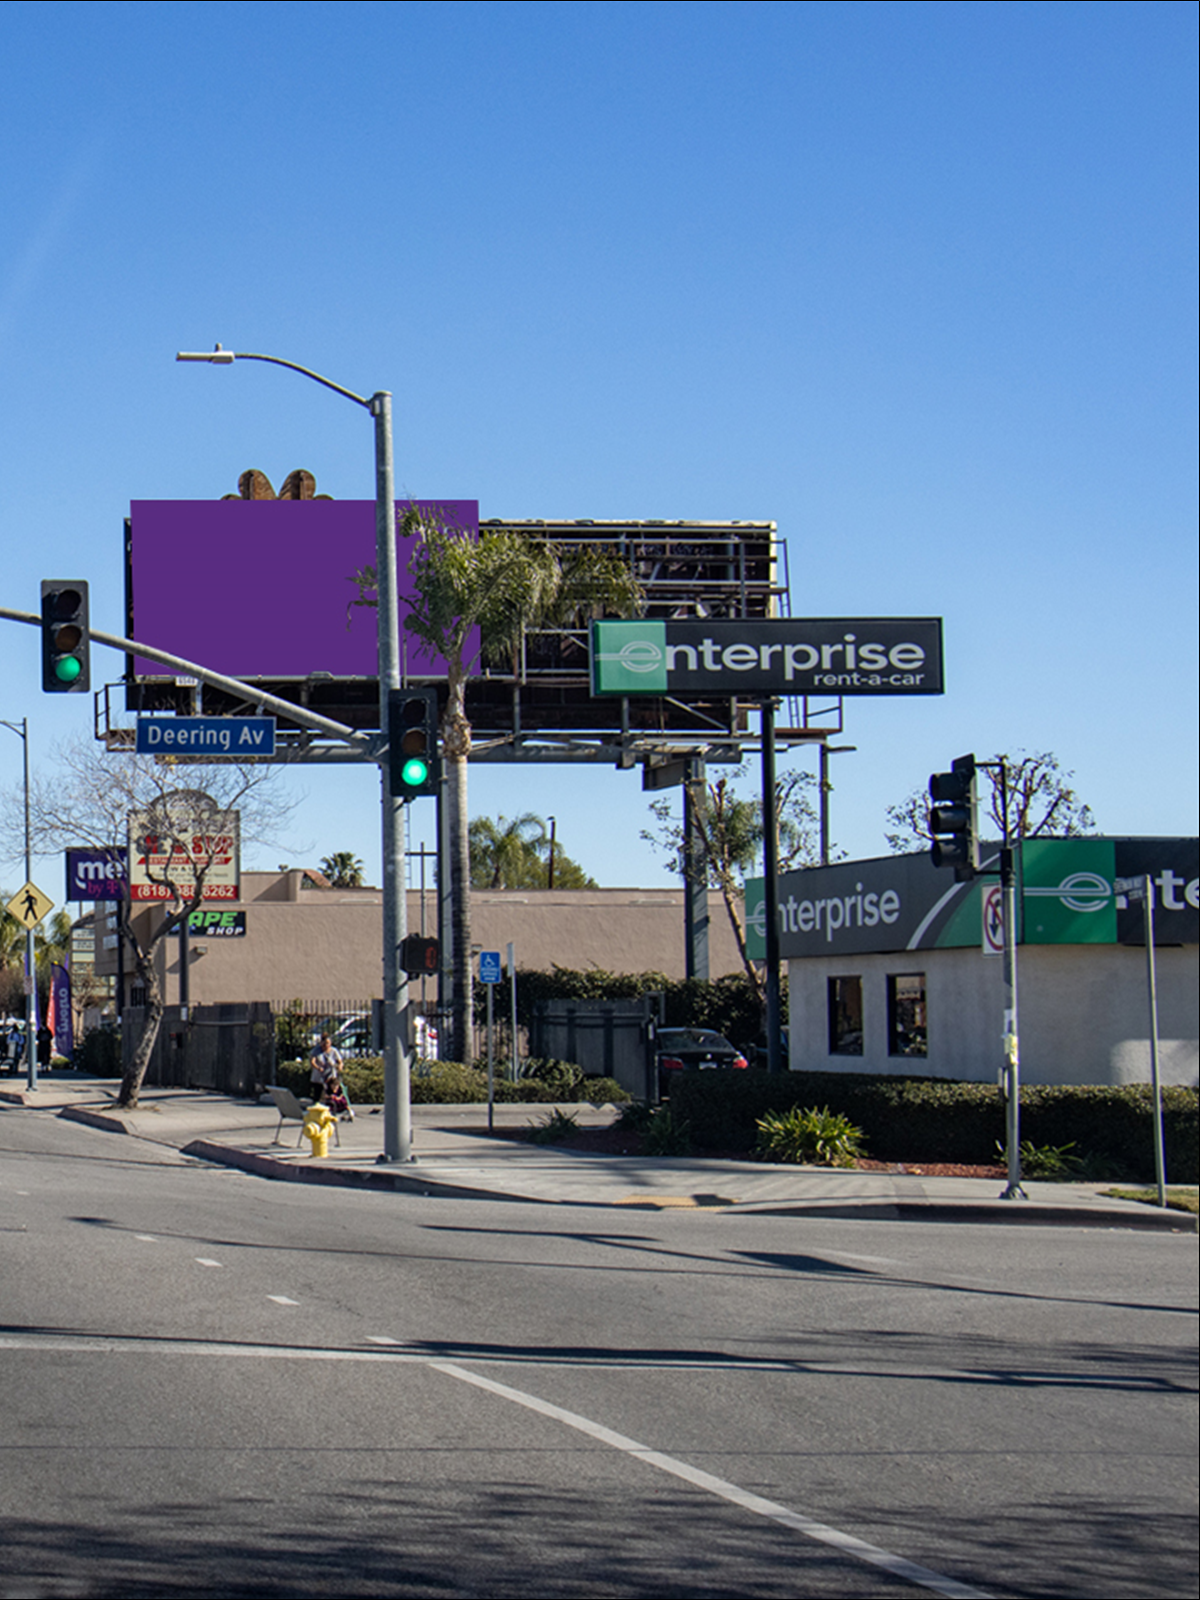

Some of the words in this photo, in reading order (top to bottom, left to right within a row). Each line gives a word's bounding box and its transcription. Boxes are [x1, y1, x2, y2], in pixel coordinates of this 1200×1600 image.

[617, 634, 926, 681] enterprise
[813, 672, 925, 687] rent-a-car
[147, 725, 231, 751] Deering
[238, 725, 264, 745] Av
[137, 885, 171, 899] (818)
[175, 911, 238, 927] APE
[206, 926, 244, 936] SHOP
